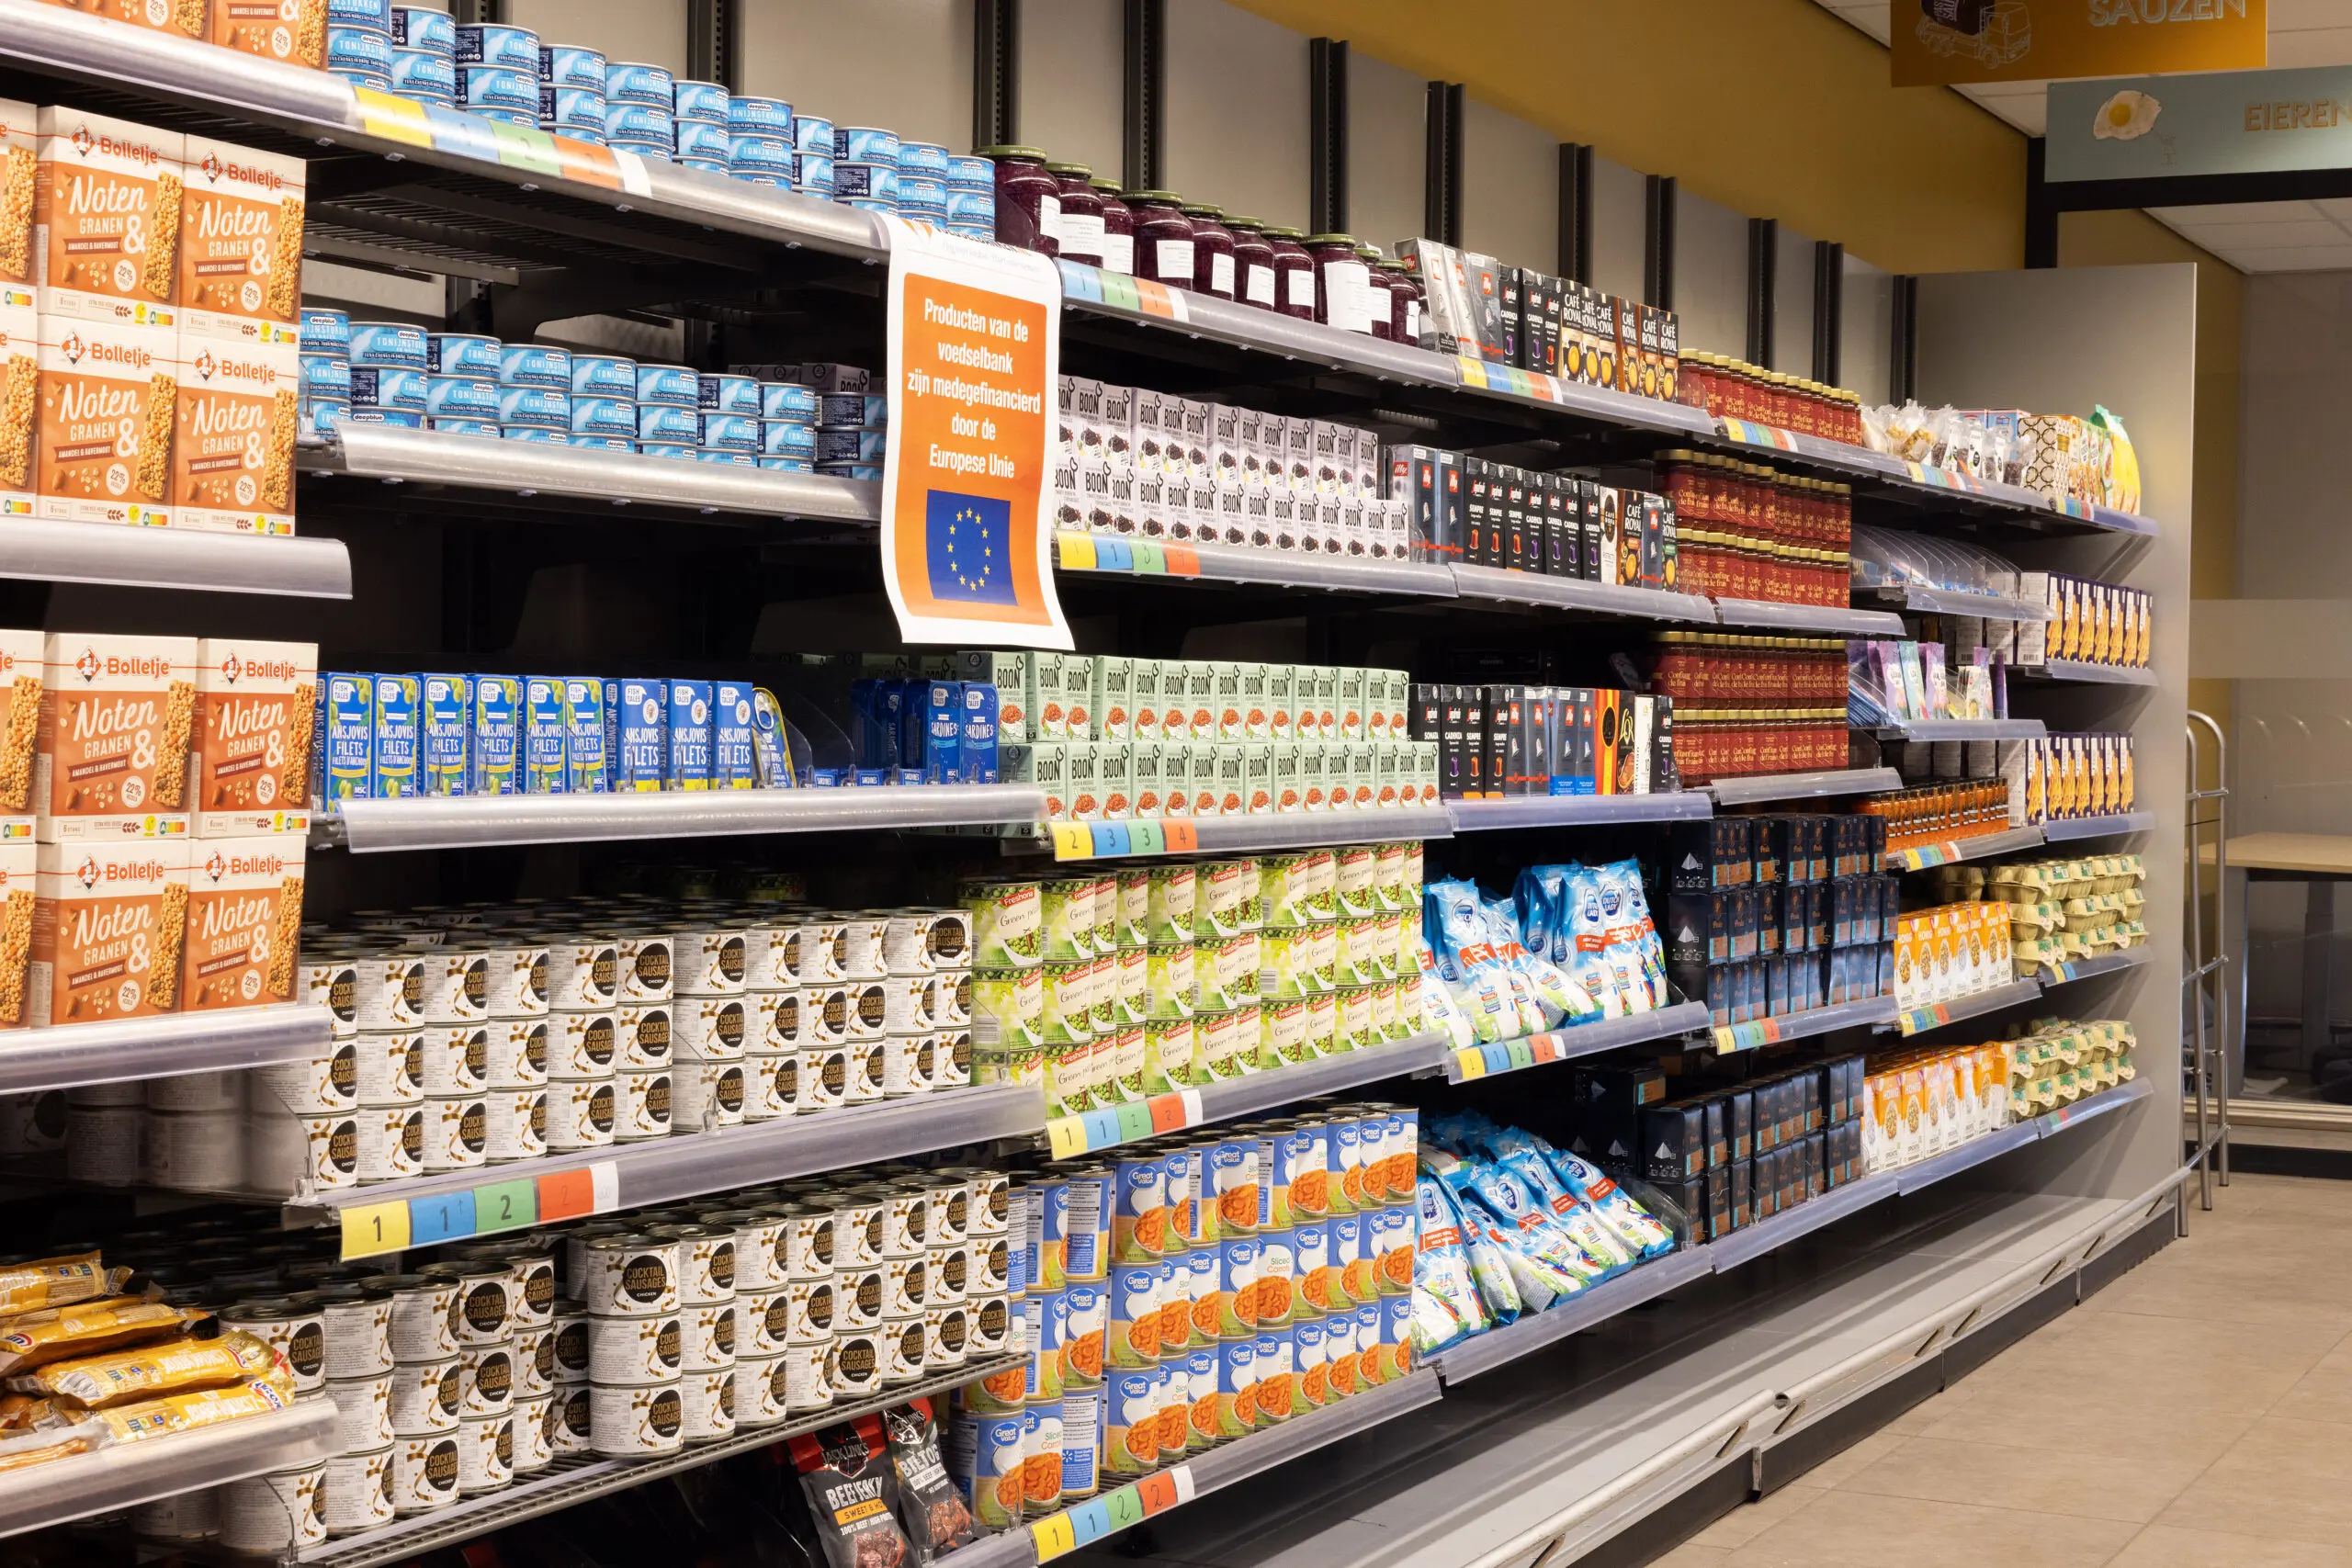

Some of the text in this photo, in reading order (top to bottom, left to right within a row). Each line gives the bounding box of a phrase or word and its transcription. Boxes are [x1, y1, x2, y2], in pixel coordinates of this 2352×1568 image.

[100, 136, 160, 166] Bolletje
[228, 163, 282, 191] Bolletje
[69, 175, 148, 215] Noten
[198, 200, 272, 239] Noten
[80, 215, 146, 254] GRANEN &
[209, 237, 271, 276] GRANEN &
[1565, 290, 1579, 309] CAFÉ
[924, 298, 1028, 342] Producten van de
[1564, 308, 1582, 323] ROYAL
[1643, 318, 1657, 333] CAFÉ
[1642, 334, 1657, 351] ROYAL
[92, 343, 151, 368] Bolletje
[938, 341, 1012, 375] voedselbank
[221, 360, 276, 384] Bolletje
[908, 367, 1041, 414] zijn medegefinancierd
[59, 381, 141, 423] Noten
[1106, 400, 1127, 421] BOON
[193, 397, 266, 436] Noten
[1140, 404, 1159, 425] BOON
[952, 412, 995, 441] door de
[70, 418, 139, 457] GRANEN &
[202, 432, 265, 469] GRANEN &
[929, 443, 1014, 479] Europese Unie
[1395, 464, 1408, 475] illy
[1086, 471, 1109, 493] BOON
[1140, 483, 1160, 504] BOON
[1223, 494, 1241, 513] BOON
[1627, 503, 1642, 517] CAFÉ
[1625, 518, 1642, 532] ROYAL
[107, 657, 169, 680] Bolletje
[245, 661, 296, 682] Bolletje
[334, 683, 348, 692] FISH
[997, 669, 1020, 690] BOON
[1040, 669, 1059, 688] BOON
[1107, 672, 1126, 692] BOON
[1192, 677, 1211, 695] BOON
[74, 698, 157, 741] Noten
[219, 699, 286, 740] Noten
[333, 725, 368, 739] ANSJOVIS
[379, 725, 413, 739] ANSJOVIS
[481, 724, 514, 738] ANSJOVIS
[531, 724, 562, 738] ANSJOVIS
[624, 728, 658, 743] ANSJOVIS
[673, 728, 707, 743] ANSJOVIS
[932, 722, 958, 738] SARDINES
[965, 724, 993, 739] SARDINES
[85, 729, 155, 769] GRANEN &
[228, 729, 284, 768] GRANEN &
[336, 741, 363, 756] FILETS
[383, 740, 409, 755] FILETS
[1037, 761, 1060, 781] BOON
[1072, 759, 1093, 779] BOON
[355, 785, 366, 794] MSC
[1069, 827, 1186, 850] 2 3 3 4
[1342, 852, 1369, 865] Freshona
[1381, 848, 1403, 861] Freshona
[107, 863, 164, 884] Bolletje
[231, 857, 282, 875] Bolletje
[1338, 870, 1360, 883] Green
[1004, 891, 1034, 907] Freshona
[1602, 896, 1620, 906] DUTCH
[74, 904, 153, 950] Noten
[202, 897, 272, 939] Noten
[1000, 911, 1027, 928] Green
[84, 933, 151, 973] GRANEN &
[211, 925, 270, 963] GRANEN &
[638, 964, 670, 976] SAUSAGES
[639, 954, 669, 967] COCKTAIL
[1066, 1110, 1173, 1146] 1 1 2 2
[1132, 1172, 1154, 1180] Great
[373, 1215, 381, 1242] 1
[440, 1206, 448, 1232] 1
[500, 1195, 512, 1221] 2
[627, 1267, 664, 1279] COCKTAIL
[1127, 1277, 1149, 1286] Great
[626, 1277, 666, 1290] SAUSAGES
[469, 1293, 504, 1308] COCKTAIL
[1070, 1294, 1092, 1303] Great
[468, 1306, 505, 1320] SAUSAGES
[843, 1348, 874, 1360] COCKTAIL
[842, 1359, 875, 1371] SAUSAGES
[1125, 1382, 1147, 1391] Great
[995, 1428, 1018, 1438] Great
[825, 1483, 857, 1510] BEEF
[844, 1506, 868, 1520] SWEET
[1053, 1484, 1163, 1547] 1 1 2 2
[840, 1524, 857, 1536] 100%
